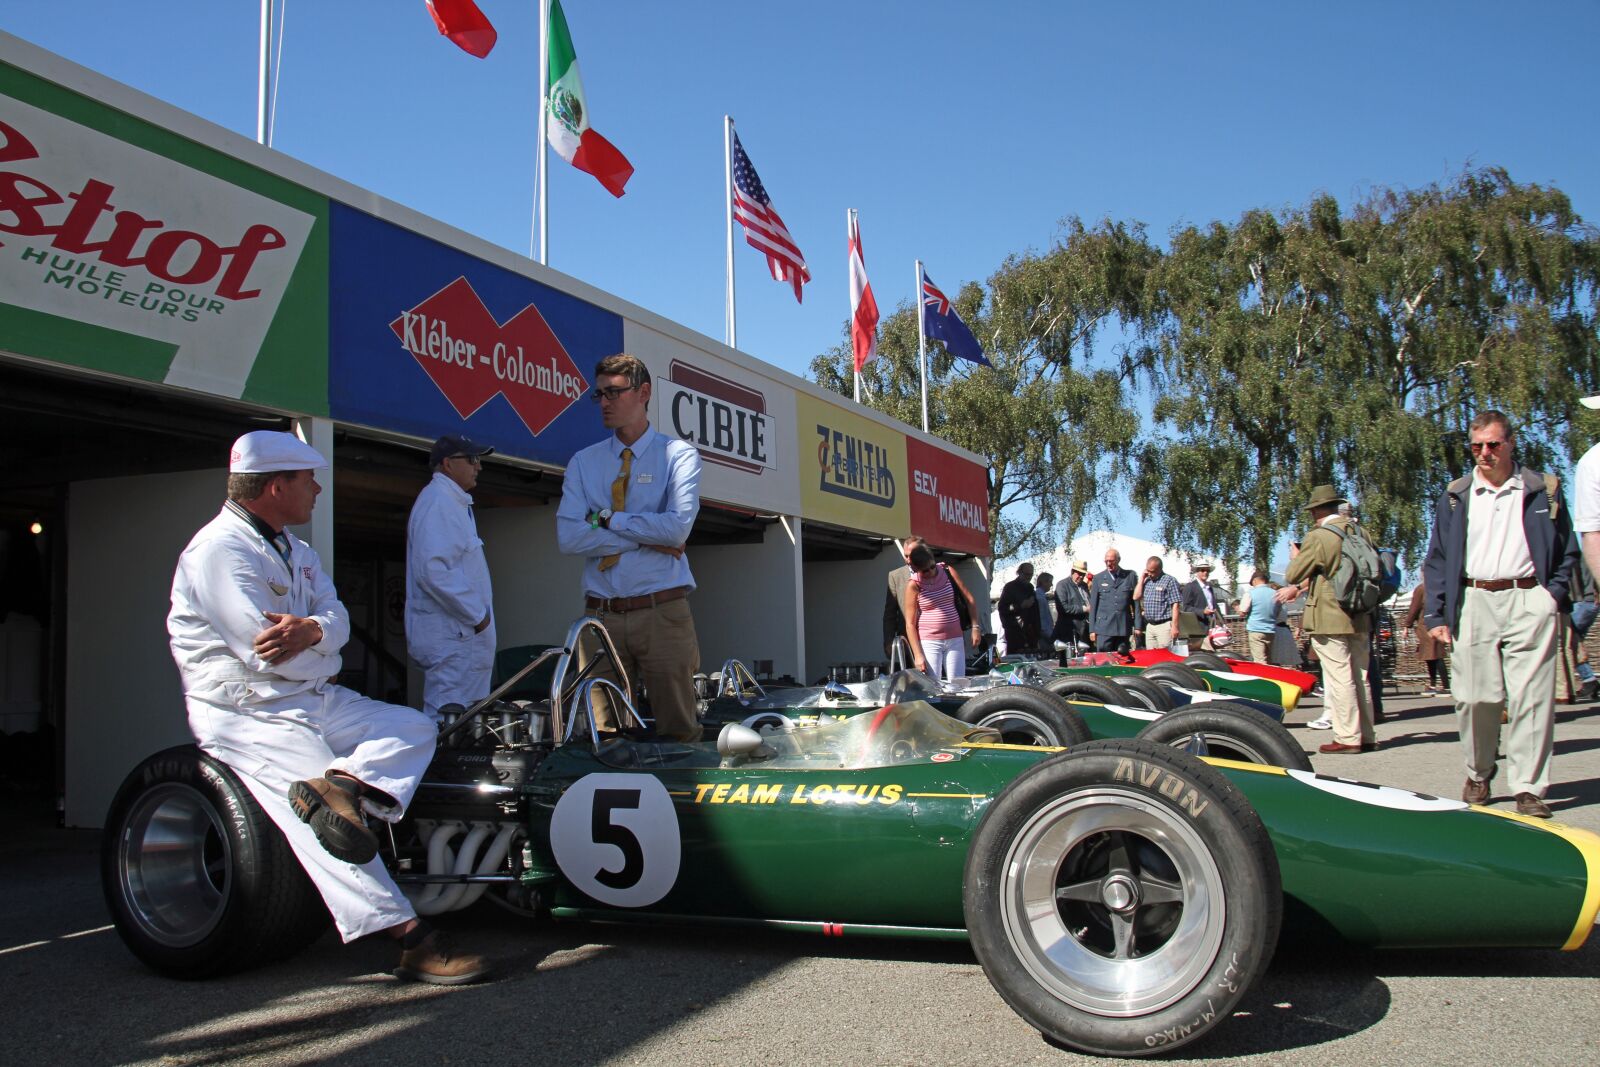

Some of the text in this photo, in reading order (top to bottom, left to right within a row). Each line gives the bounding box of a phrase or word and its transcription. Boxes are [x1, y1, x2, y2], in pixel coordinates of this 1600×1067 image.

[21, 247, 225, 315] HUILE POUR
[43, 270, 200, 323] MOTEURS
[816, 424, 896, 508] ZENITH
[939, 494, 986, 532] MARCHAL
[144, 760, 193, 786] AVON
[457, 754, 488, 763] FORD
[694, 783, 903, 805] TEAM LOTUS
[1113, 757, 1210, 818] AVON
[591, 788, 645, 890] 5
